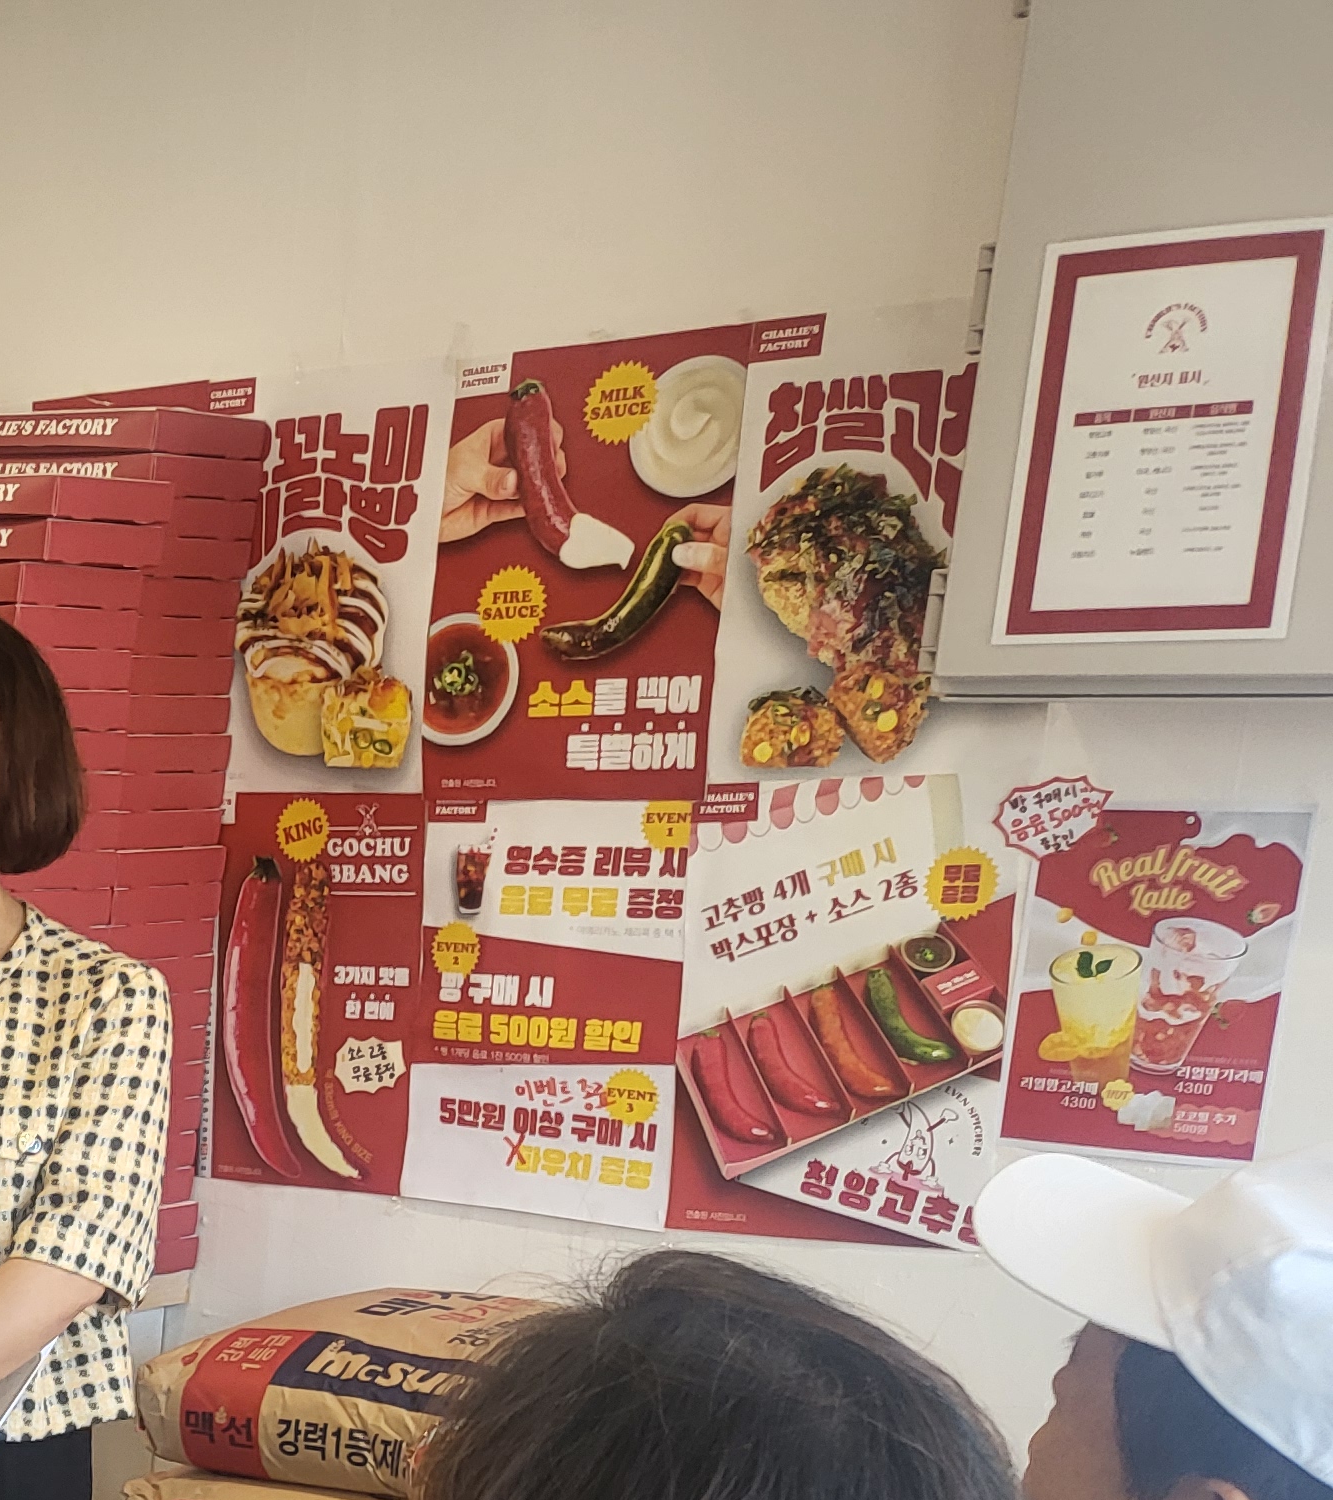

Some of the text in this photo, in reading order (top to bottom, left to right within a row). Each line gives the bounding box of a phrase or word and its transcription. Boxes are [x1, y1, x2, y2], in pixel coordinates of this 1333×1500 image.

[762, 325, 820, 340] CHARLIE'S
[759, 338, 810, 353] FACTORY
[462, 363, 507, 377] CHARLIE'S
[461, 375, 500, 388] FACTORY
[210, 386, 252, 400] CHARLIE'S
[599, 386, 645, 403] MILK
[210, 397, 246, 410] FACTORY
[589, 402, 651, 420] SAUCE
[34, 417, 119, 438] FACTORY
[37, 462, 119, 478] FACTORY
[492, 590, 532, 605] FIRE
[482, 603, 540, 622] SAUCE
[527, 678, 628, 719] 소스를
[566, 730, 698, 771] 특별하게
[435, 805, 478, 815] FACTORY
[699, 803, 747, 814] FACTORY
[1010, 797, 1104, 842] 음료 500원
[282, 821, 323, 846] KING
[666, 828, 674, 837] 1
[327, 838, 410, 857] GOCHU
[504, 845, 688, 878] 영수증 리뷰 시
[331, 865, 409, 885] BBANG
[1094, 846, 1243, 899] Real fruit
[701, 837, 897, 932] 고추빵 4개 시
[626, 888, 684, 919] 증정
[1132, 884, 1193, 916] Latte
[710, 869, 919, 962] 박스포장 + 소스 2종
[436, 942, 476, 953] EVENT
[452, 956, 460, 966] 2
[334, 966, 375, 985] 3가지
[468, 973, 555, 1008] 구매 시
[434, 1010, 642, 1052] 음료 500원 할인
[347, 1045, 365, 1062] 소스
[515, 1077, 574, 1107] 이벤트
[607, 1088, 656, 1102] EVENT
[1174, 1081, 1213, 1095] 4300
[626, 1103, 634, 1113] 3
[1060, 1096, 1096, 1110] 4300
[439, 1097, 657, 1151] 5만원 이상 구매 시
